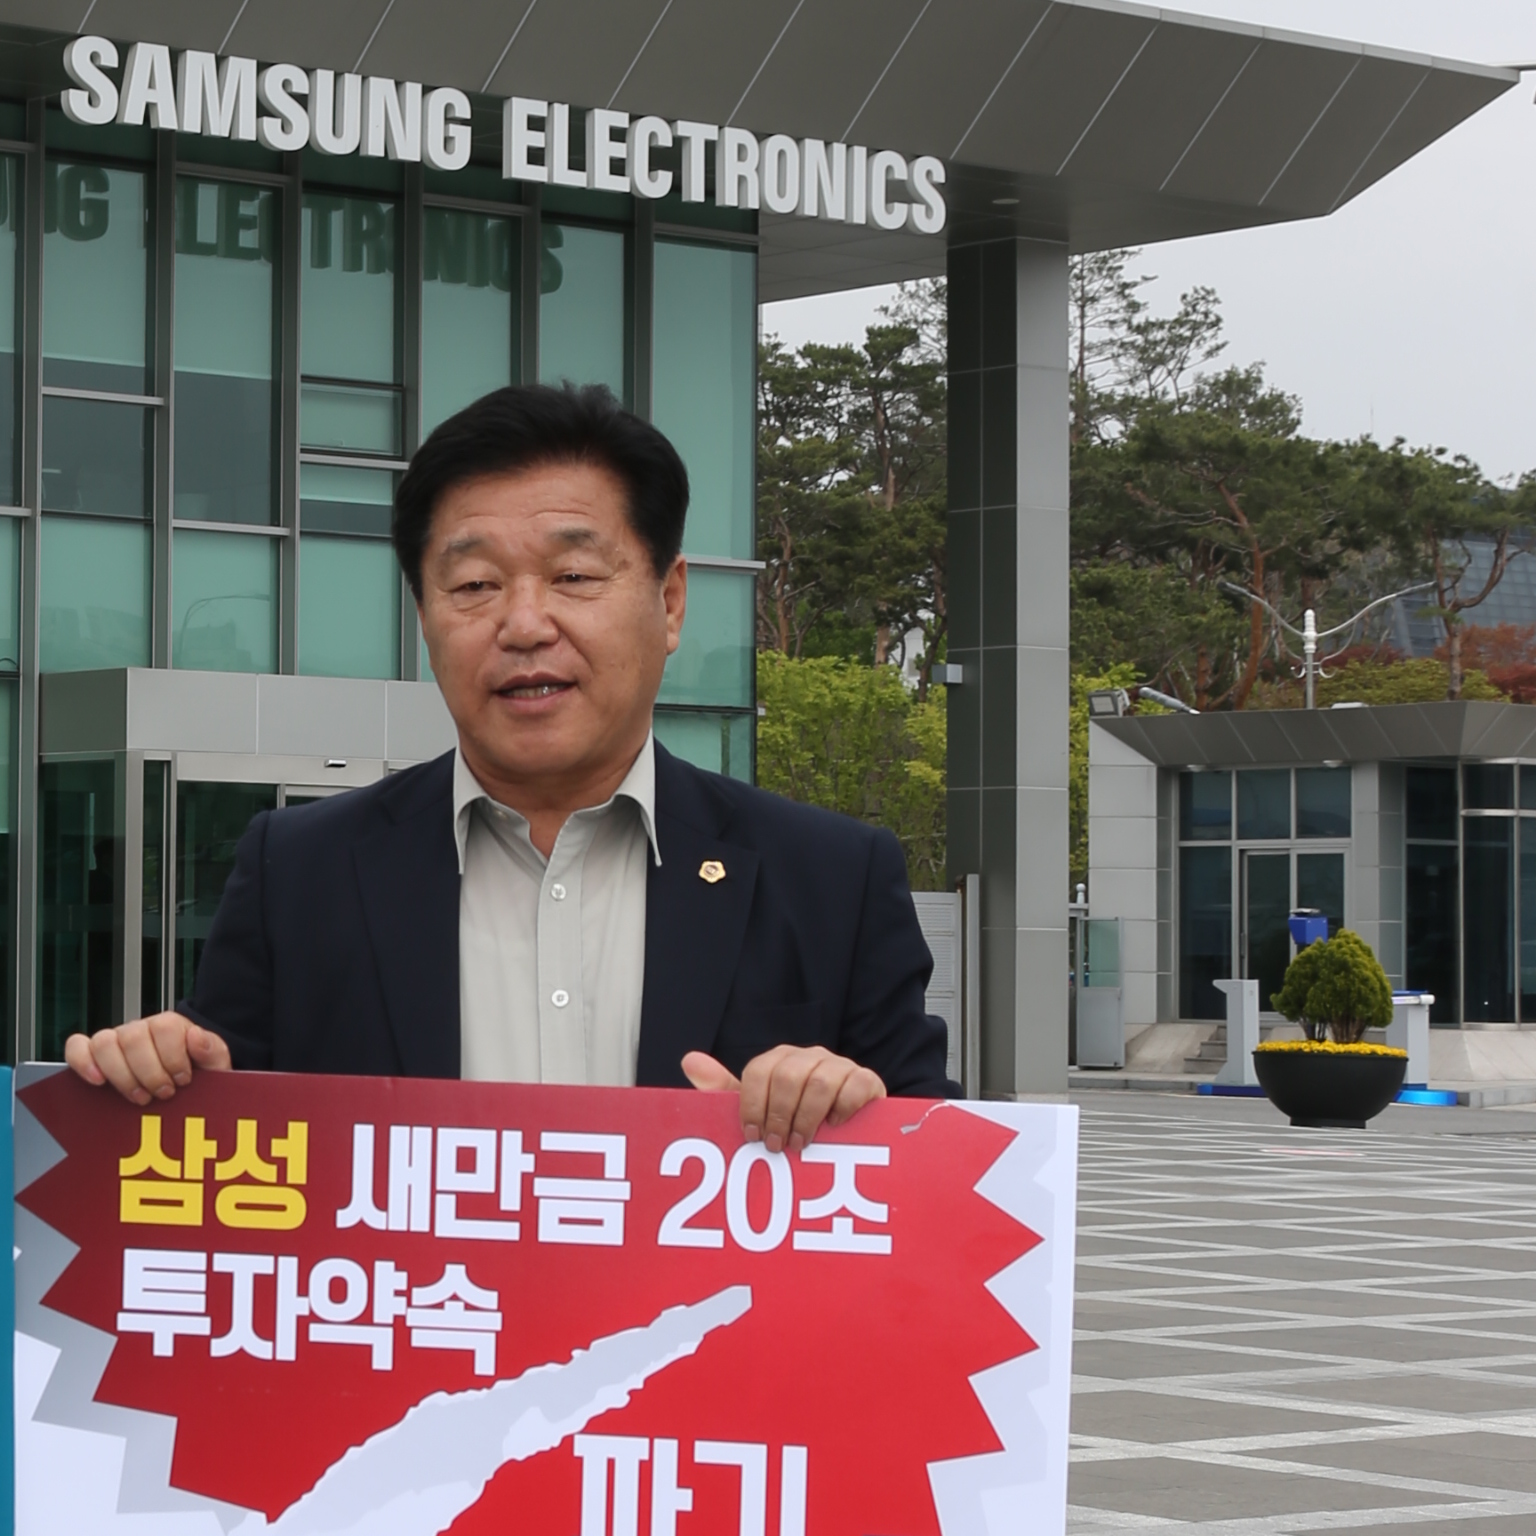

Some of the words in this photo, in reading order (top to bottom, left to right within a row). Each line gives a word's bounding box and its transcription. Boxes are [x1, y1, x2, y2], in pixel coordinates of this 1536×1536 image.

[61, 35, 472, 171] SAMSUNG
[501, 95, 948, 235] ELECTRONICS
[117, 1114, 310, 1231] 삼성
[335, 1122, 631, 1246] 새만금
[657, 1136, 894, 1255] 20조
[116, 1246, 503, 1375] 투자약속
